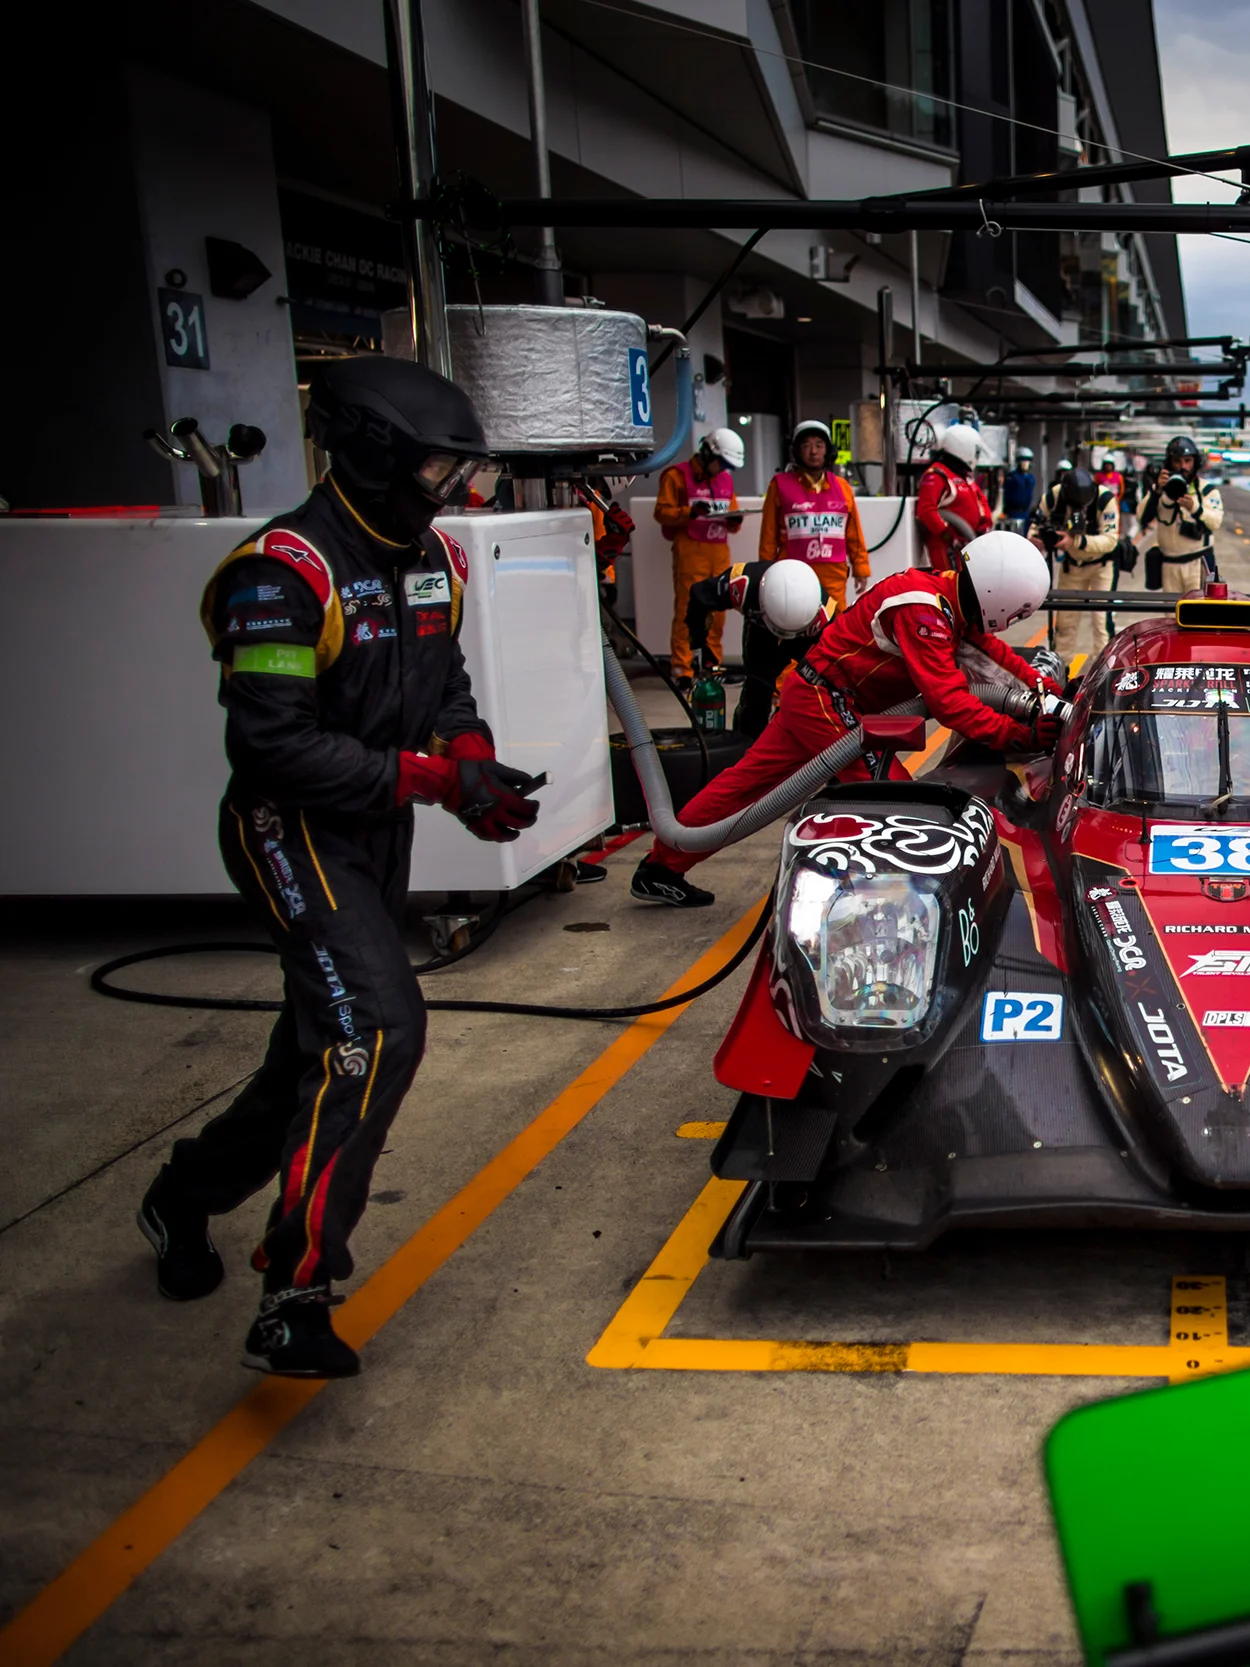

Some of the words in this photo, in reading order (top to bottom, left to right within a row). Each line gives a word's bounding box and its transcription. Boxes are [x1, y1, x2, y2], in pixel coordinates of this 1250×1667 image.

[287, 240, 322, 265] ACKIE
[325, 249, 356, 273] CHAN
[358, 258, 375, 278] DC
[376, 265, 408, 287] RACIN
[166, 301, 205, 358] 31
[789, 516, 808, 529] PIT
[814, 515, 844, 528] LANE
[414, 577, 445, 591] WEC
[1152, 679, 1198, 689] SPARK
[1207, 680, 1237, 690] ROLL
[1151, 698, 1240, 709] JOTA
[1165, 925, 1237, 933] RICHARD
[310, 940, 346, 998] JOTA
[338, 1004, 361, 1041] Sport
[991, 999, 1055, 1032] P2
[1207, 1012, 1244, 1025] DPLS
[1138, 1002, 1188, 1082] JOTA
